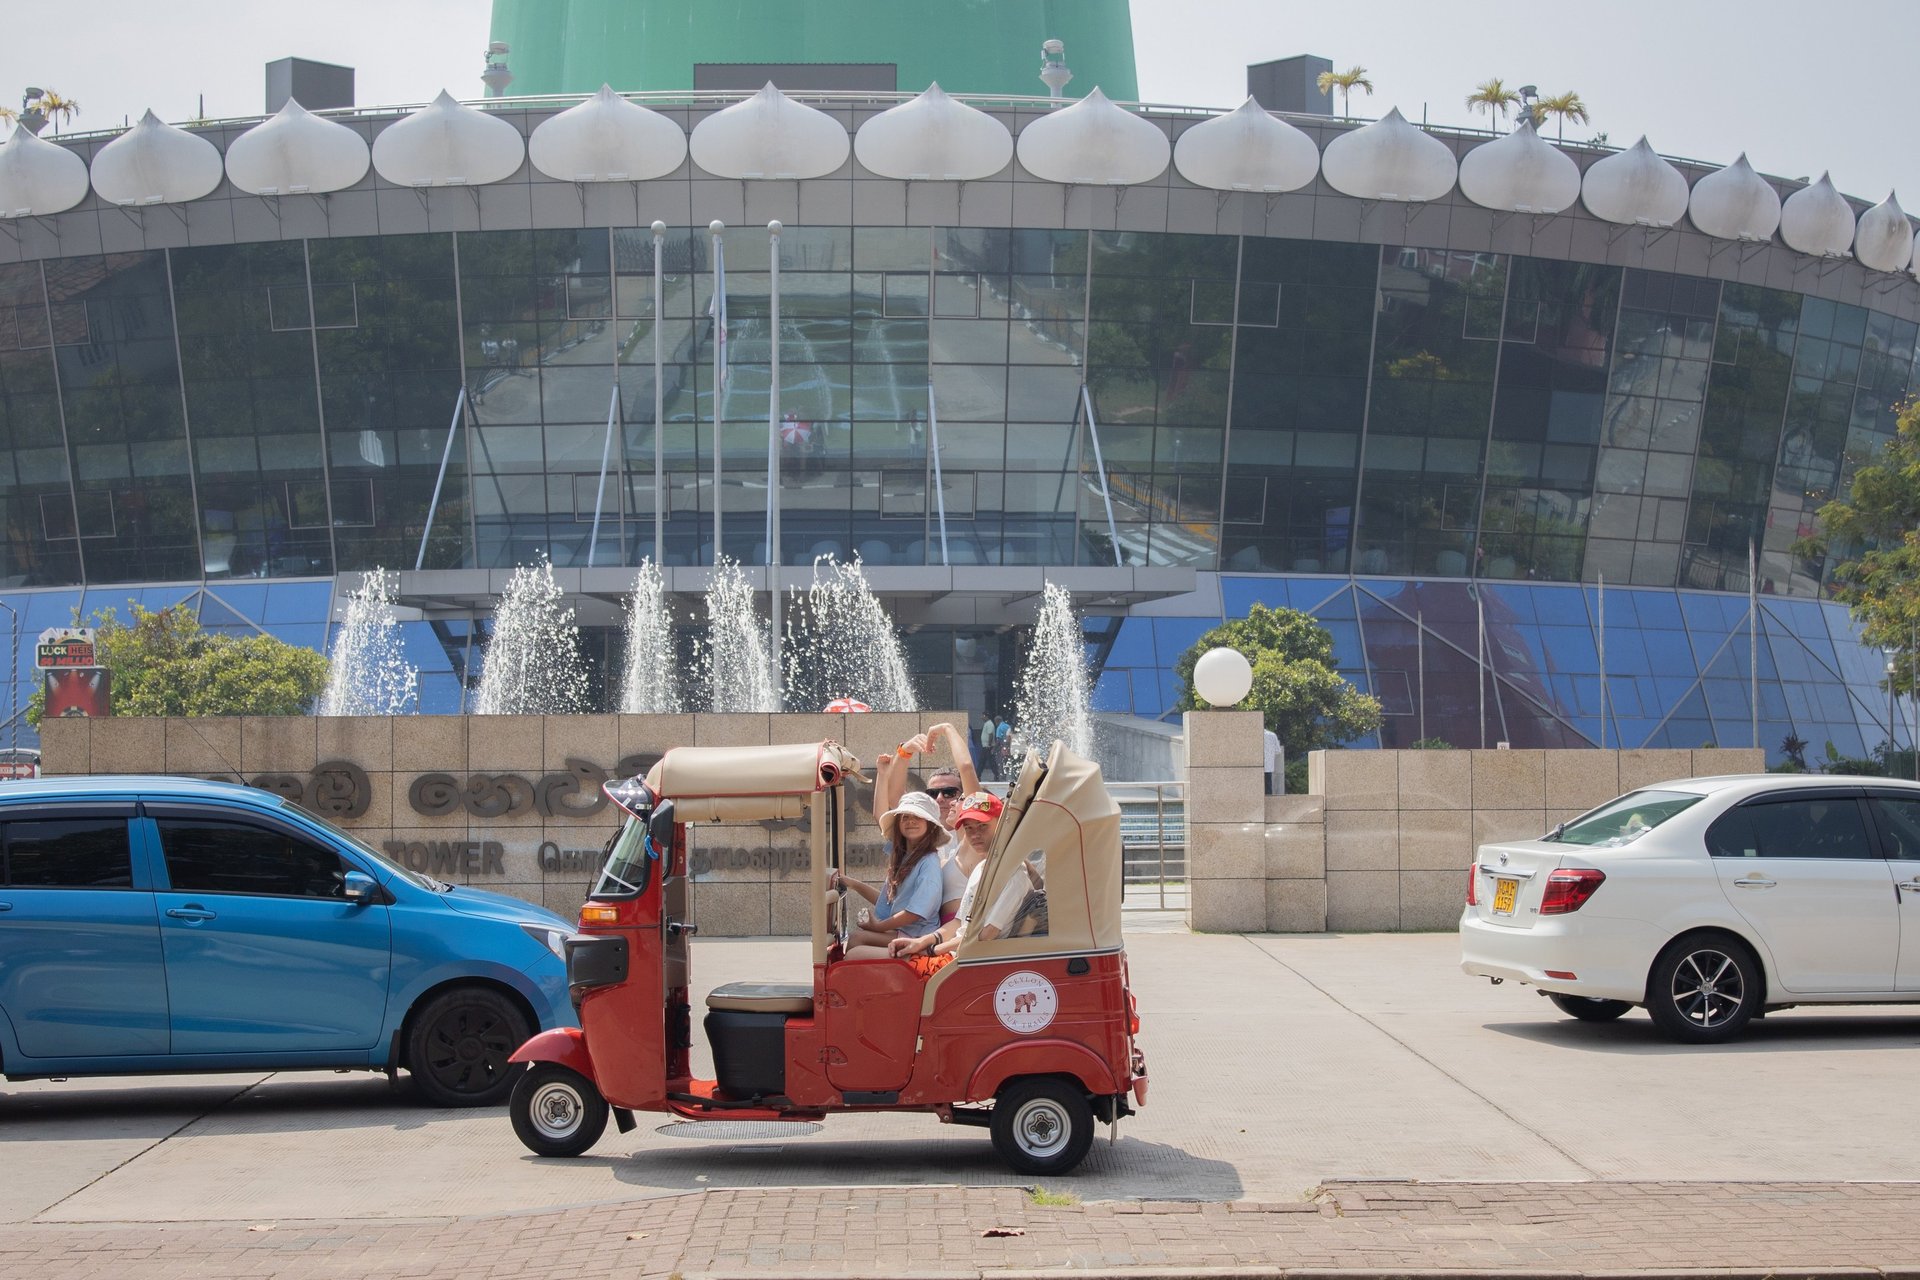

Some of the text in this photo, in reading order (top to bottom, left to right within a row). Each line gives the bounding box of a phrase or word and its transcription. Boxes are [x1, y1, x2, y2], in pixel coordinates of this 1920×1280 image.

[41, 646, 67, 656] LUCK
[383, 841, 506, 875] TOWER
[1007, 976, 1044, 988] CEYLON
[1021, 1011, 1050, 1029] TRAILS
